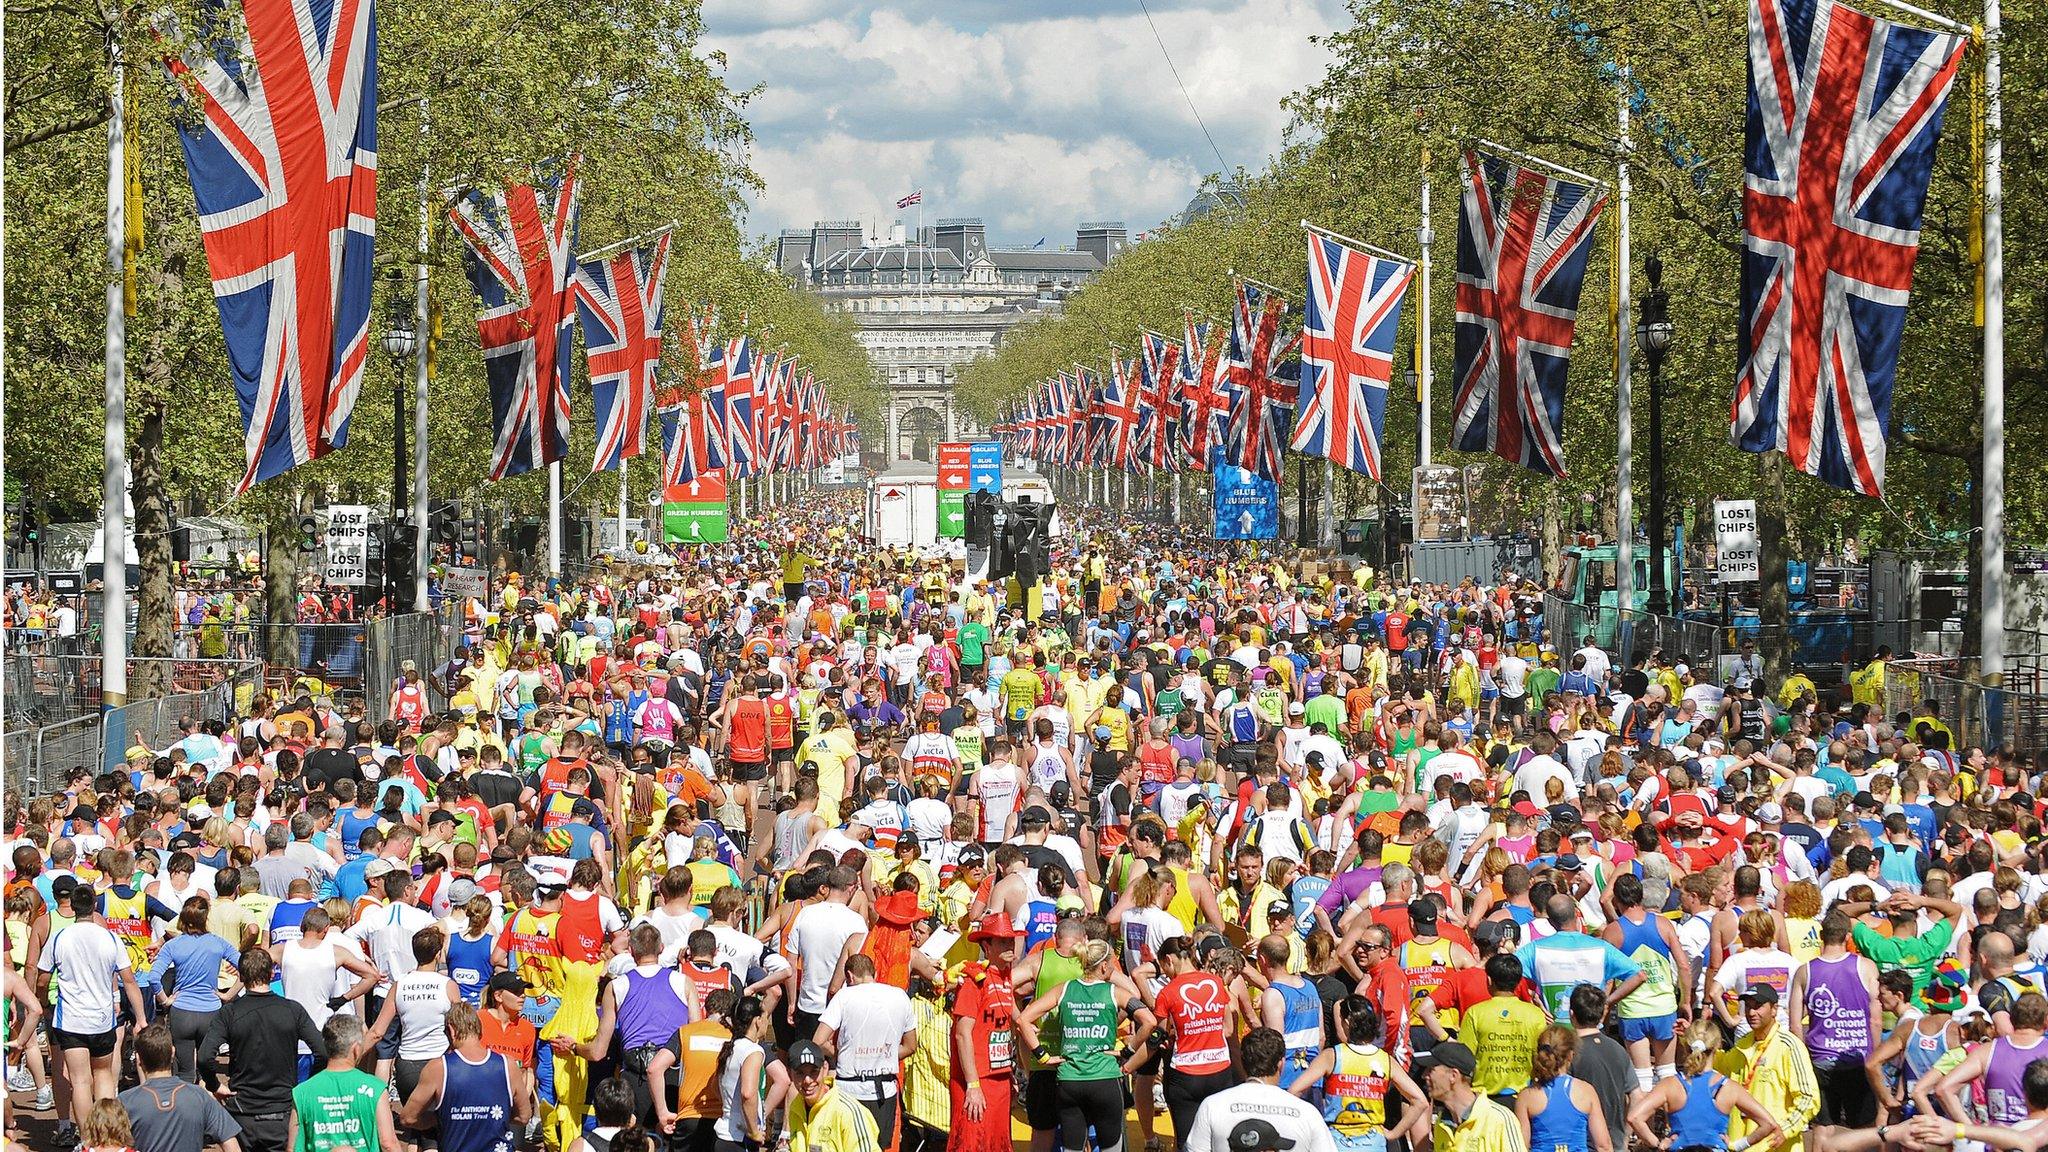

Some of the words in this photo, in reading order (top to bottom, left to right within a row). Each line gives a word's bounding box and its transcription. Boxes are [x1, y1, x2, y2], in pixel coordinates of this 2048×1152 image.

[1233, 488, 1256, 496] BLUE
[1225, 497, 1268, 505] NUMBERS
[333, 514, 362, 524] LOST
[1721, 509, 1751, 519] LOST
[329, 527, 365, 538] CHIPS
[1718, 522, 1755, 533] CHIPS
[331, 555, 361, 565] LOST
[1722, 550, 1754, 560] LOST
[1719, 562, 1757, 573] CHIPS
[327, 568, 364, 578] CHIPS
[455, 574, 478, 584] HEART
[447, 582, 482, 592] RESEARCH
[1297, 896, 1317, 930] 2
[513, 933, 549, 944] CHILDREN
[1404, 965, 1447, 976] CHILDREN
[402, 983, 441, 992] EVERYONE
[402, 994, 437, 1002] THEATRE
[1067, 1001, 1086, 1009] There's
[1091, 1001, 1106, 1009] child
[1071, 1009, 1100, 1018] depending
[1823, 1018, 1867, 1028] Ormond
[1063, 1025, 1109, 1039] teamGO
[1835, 1027, 1867, 1038] Street
[1487, 1032, 1528, 1043] Changing
[1824, 1037, 1868, 1049] Hospital
[485, 1044, 522, 1054] KATRINA
[1338, 1074, 1384, 1087] CHILDREN
[461, 1106, 490, 1114] ANTHONY
[1230, 1102, 1300, 1119] SHOULDERS
[313, 1118, 360, 1135] teamGO
